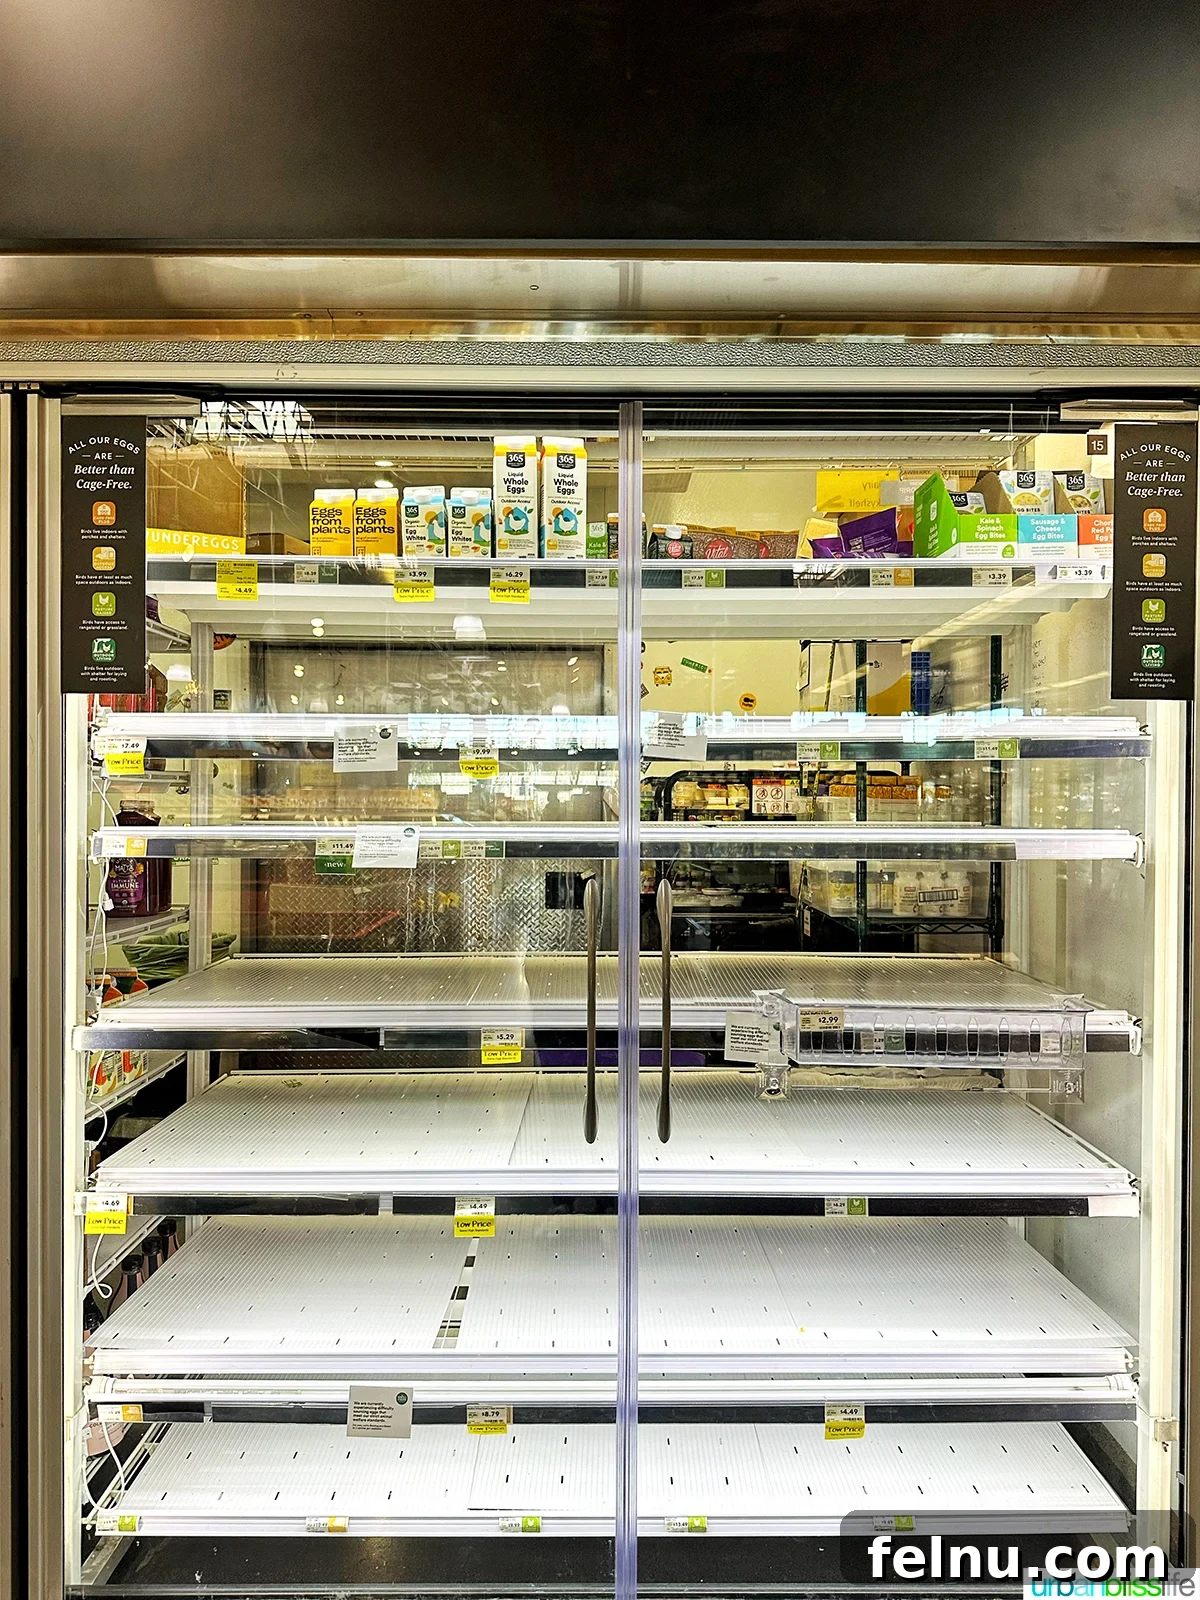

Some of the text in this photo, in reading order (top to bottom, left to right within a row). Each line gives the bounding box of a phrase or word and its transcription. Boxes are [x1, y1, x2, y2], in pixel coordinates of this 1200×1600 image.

[68, 436, 140, 454] ALL OUR EGGS
[1091, 441, 1104, 450] 15
[94, 452, 113, 460] ARE
[1120, 444, 1191, 462] ALL OUR EGGS
[508, 454, 524, 463] 365
[558, 455, 574, 463] 365
[74, 464, 135, 474] Better than
[1019, 474, 1034, 482] 365
[1068, 476, 1083, 484] 365
[1125, 472, 1186, 482] Better than
[76, 479, 132, 491] Cage-Free.
[503, 478, 529, 486] Whole
[553, 479, 579, 487] Whole
[507, 486, 525, 494] Eggs
[557, 486, 575, 495] Eggs
[1128, 486, 1183, 499] Cage-Free.
[312, 507, 343, 518] Eggs
[356, 507, 387, 518] Eggs
[311, 516, 342, 525] from
[356, 516, 386, 525] from
[312, 525, 351, 535] plants
[356, 525, 395, 535] plants
[591, 525, 603, 533] 365
[977, 524, 1004, 532] Spinach
[1035, 524, 1061, 532] Cheese
[975, 532, 988, 540] Egg
[1095, 534, 1108, 542] Egg
[472, 1220, 491, 1228] Price
